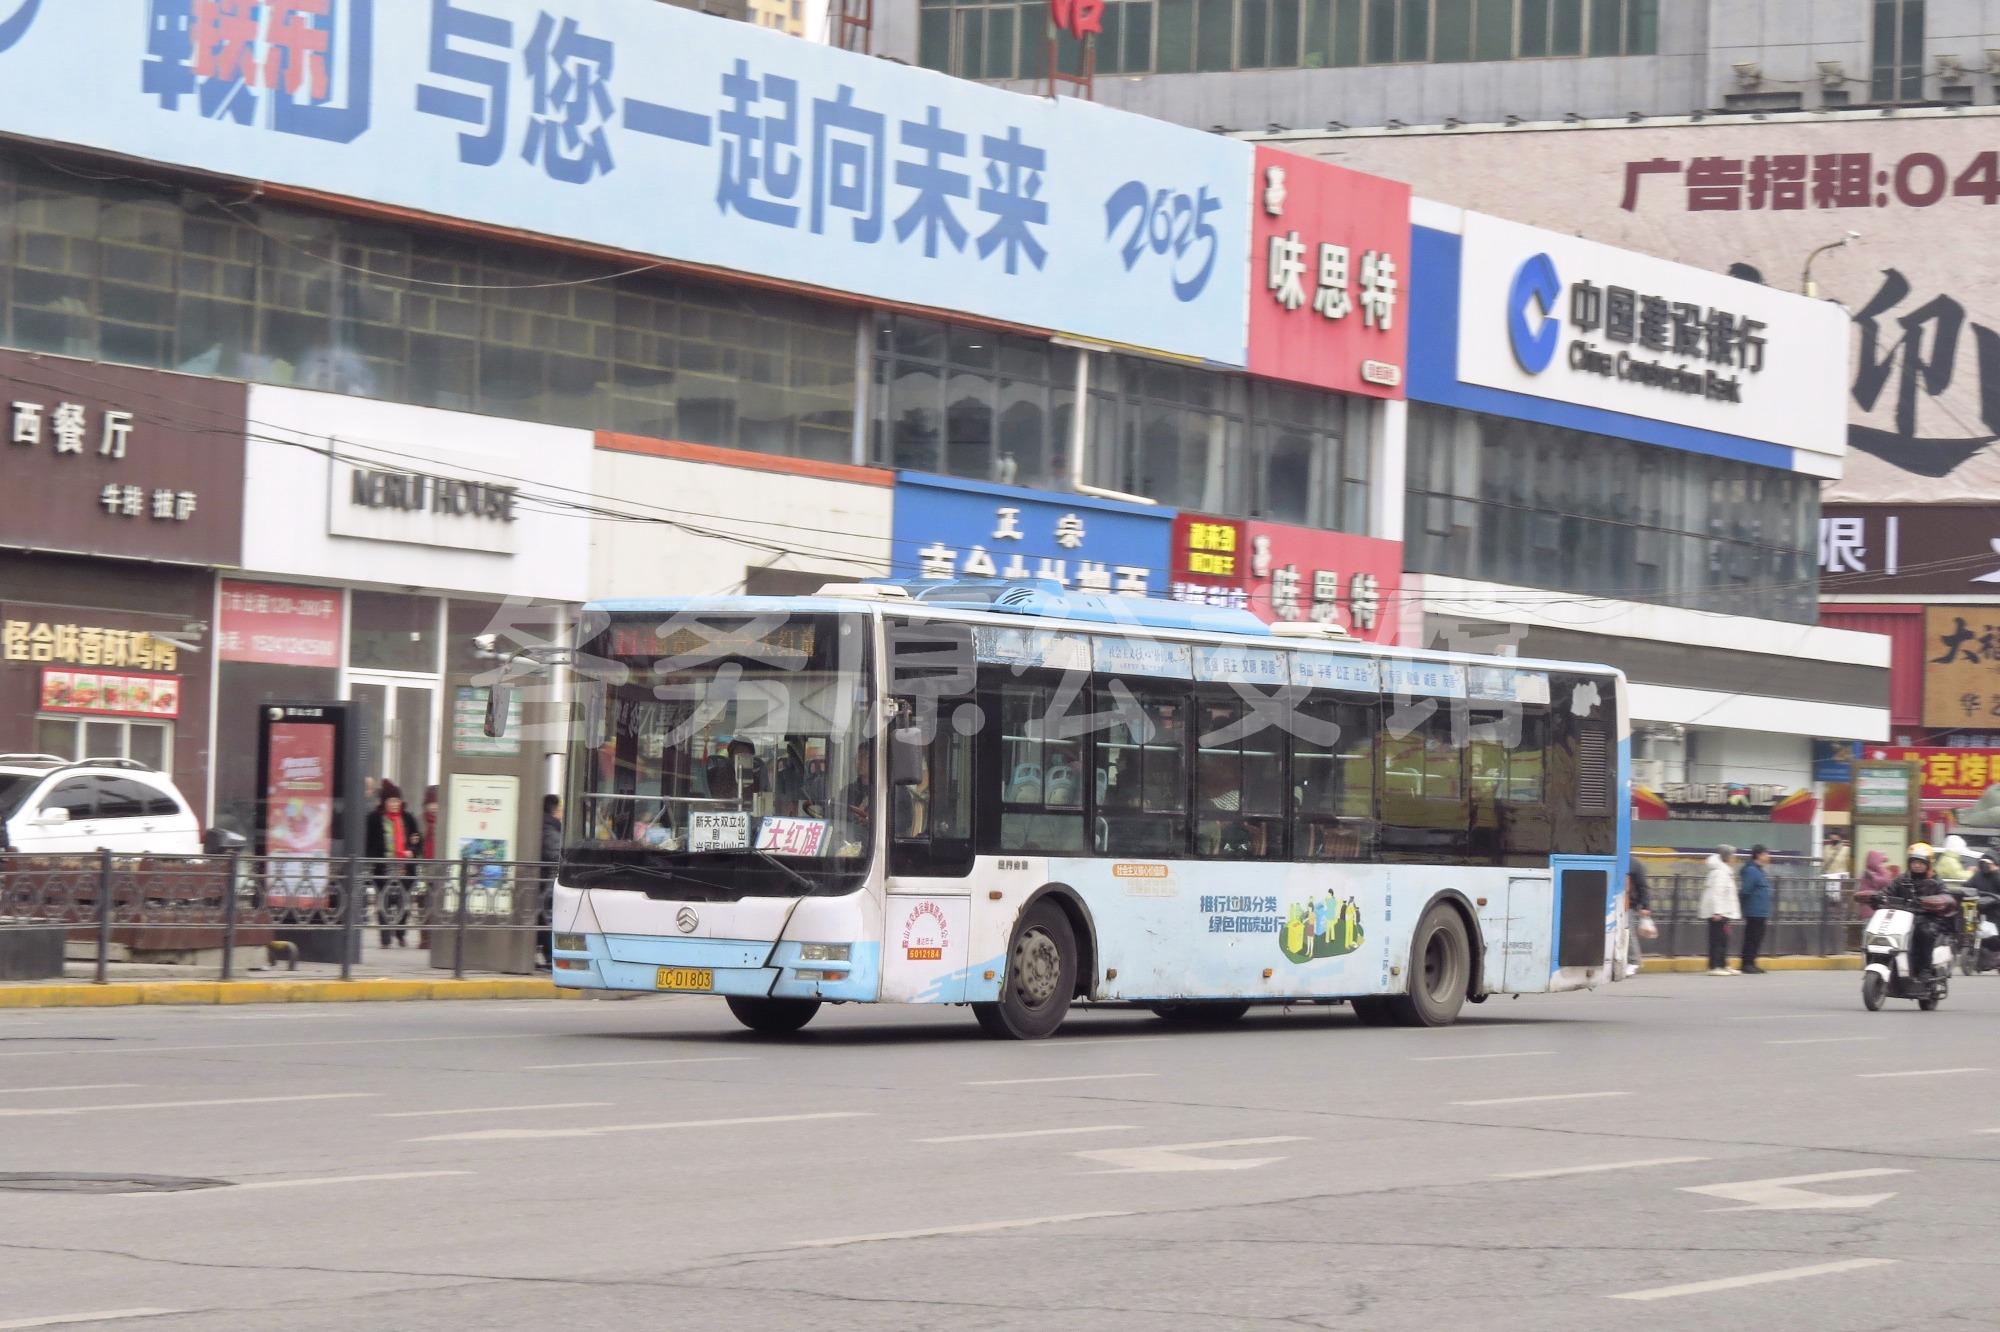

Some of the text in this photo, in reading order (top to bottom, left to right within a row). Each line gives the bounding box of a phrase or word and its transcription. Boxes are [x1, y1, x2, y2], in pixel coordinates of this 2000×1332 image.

[415, 0, 1049, 276] 与您一起向未来
[1104, 180, 1221, 302] 2025
[1268, 231, 1397, 329] 味思特
[1570, 279, 1768, 374] 中国建设银行
[11, 401, 134, 458] 西餐厅
[993, 507, 1086, 548] 正 宗
[1272, 564, 1379, 630] 味思特
[1204, 656, 1276, 675] 富强 民主 文明 和谐
[1299, 662, 1367, 682] 自由 平等 公正 法治
[765, 820, 823, 855] 大红旗
[1200, 895, 1277, 913] 推行垃圾分类
[1208, 915, 1286, 933] 绿色低碳出行
[910, 949, 940, 959] 6012184
